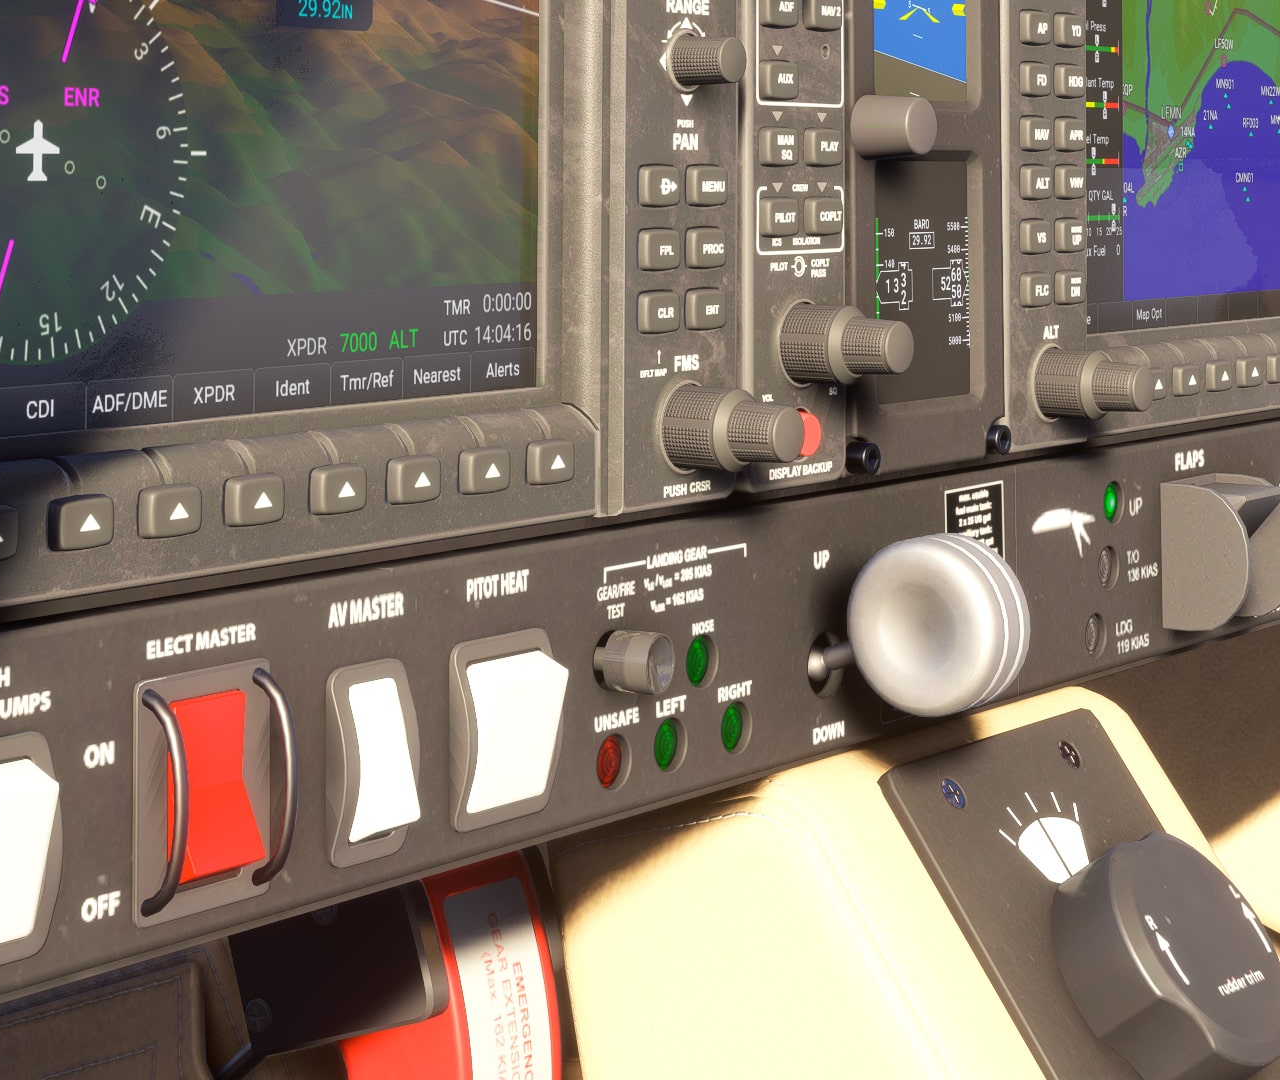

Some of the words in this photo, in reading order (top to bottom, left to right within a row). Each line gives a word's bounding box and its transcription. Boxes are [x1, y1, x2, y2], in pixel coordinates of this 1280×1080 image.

[64, 87, 100, 107] ENR
[673, 133, 698, 150] PAN
[702, 181, 725, 192] MENU
[660, 245, 674, 256] FPL
[1036, 285, 1049, 296] FLC
[444, 298, 470, 316] TMR
[482, 292, 532, 313] 0:00:00
[287, 337, 327, 358] XPDR
[340, 331, 377, 354] 7000
[388, 328, 419, 351] ALT
[443, 329, 468, 347] UTC
[474, 323, 532, 345] 14:04:16
[1043, 326, 1059, 339] ALT
[486, 360, 520, 379] Alerts
[674, 354, 699, 372] FMS
[340, 370, 394, 393] Tmr/Ref
[413, 364, 461, 385] Nearest
[193, 384, 235, 404] XPDR
[275, 379, 310, 398] Ident
[26, 399, 54, 419] CDI
[93, 389, 167, 414] ADF/DME
[1175, 449, 1204, 471] FLAPS
[1129, 498, 1142, 516] UP
[647, 550, 683, 569] LANDING
[684, 545, 707, 562] GEAR
[813, 550, 829, 569] UP
[466, 576, 498, 602] PITOT
[501, 568, 529, 596] HEAT
[328, 603, 348, 627] AV
[349, 591, 404, 625] MASTER
[607, 603, 625, 619] TEST
[692, 619, 714, 636] NOSE
[146, 631, 192, 661] ELECT
[195, 623, 255, 653] MASTER
[718, 680, 752, 703] RIGHT
[656, 695, 686, 719] LEFT
[594, 707, 639, 732] UNSAFE
[813, 721, 845, 745] DOWN
[83, 740, 115, 768] ON
[81, 890, 120, 923] OFF
[1218, 977, 1247, 997] rudder
[1244, 969, 1265, 986] trim
